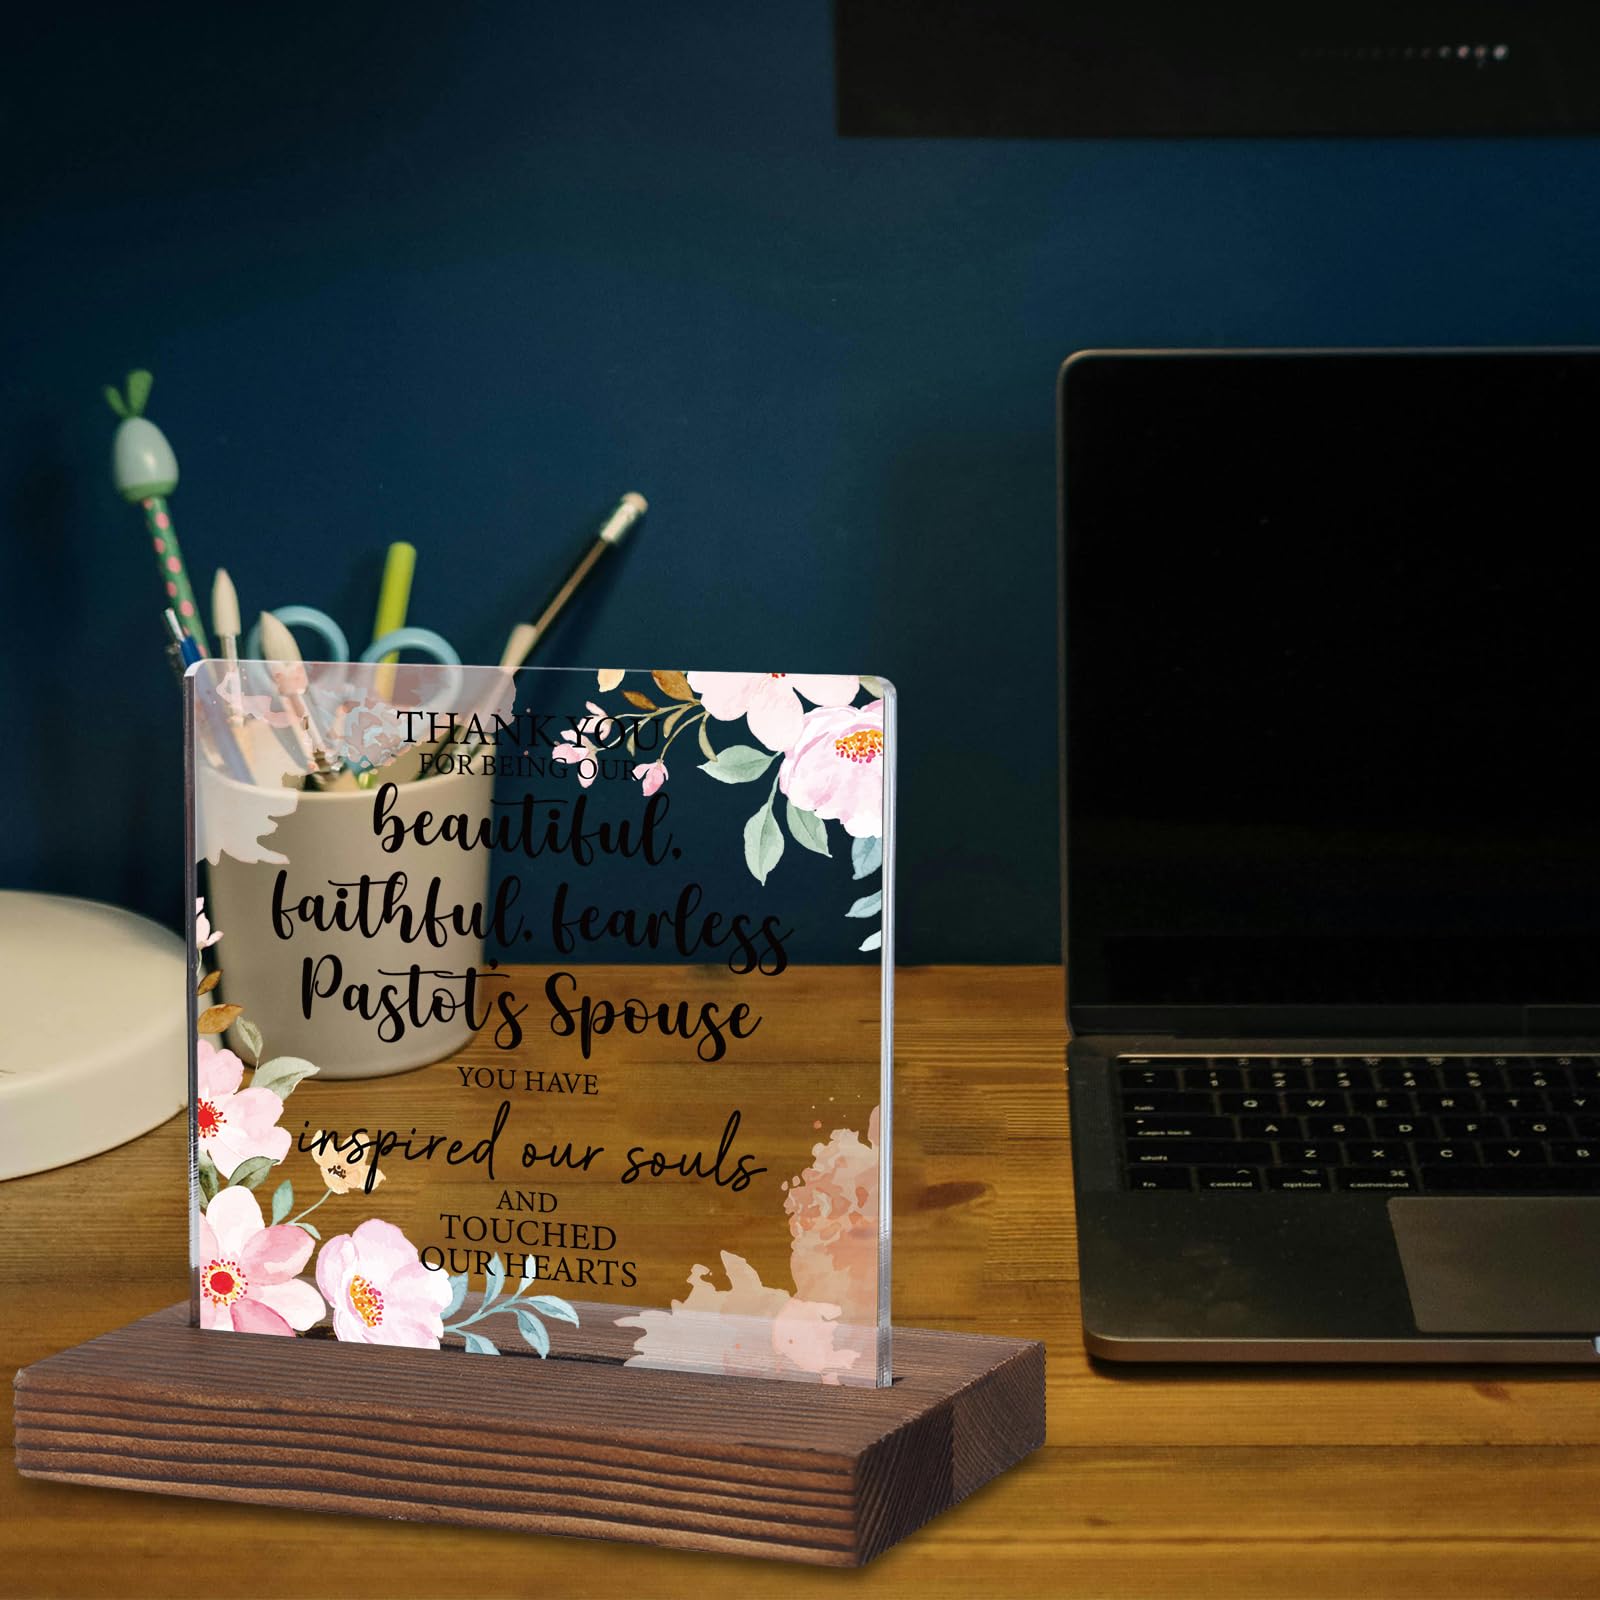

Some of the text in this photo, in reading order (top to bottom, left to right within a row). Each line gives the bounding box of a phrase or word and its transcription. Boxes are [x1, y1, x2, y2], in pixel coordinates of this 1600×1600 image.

[396, 710, 664, 752] THANK YOU
[419, 752, 639, 782] FOR BEING OUR
[553, 883, 794, 976] fearless
[545, 972, 762, 1062] Spouse
[457, 1066, 599, 1095] YOU HAVE
[297, 1100, 768, 1194] inspired our souls
[496, 1189, 558, 1213] AND
[440, 1213, 617, 1252] TOUCHED
[420, 1246, 637, 1288] OUR HEARTS
